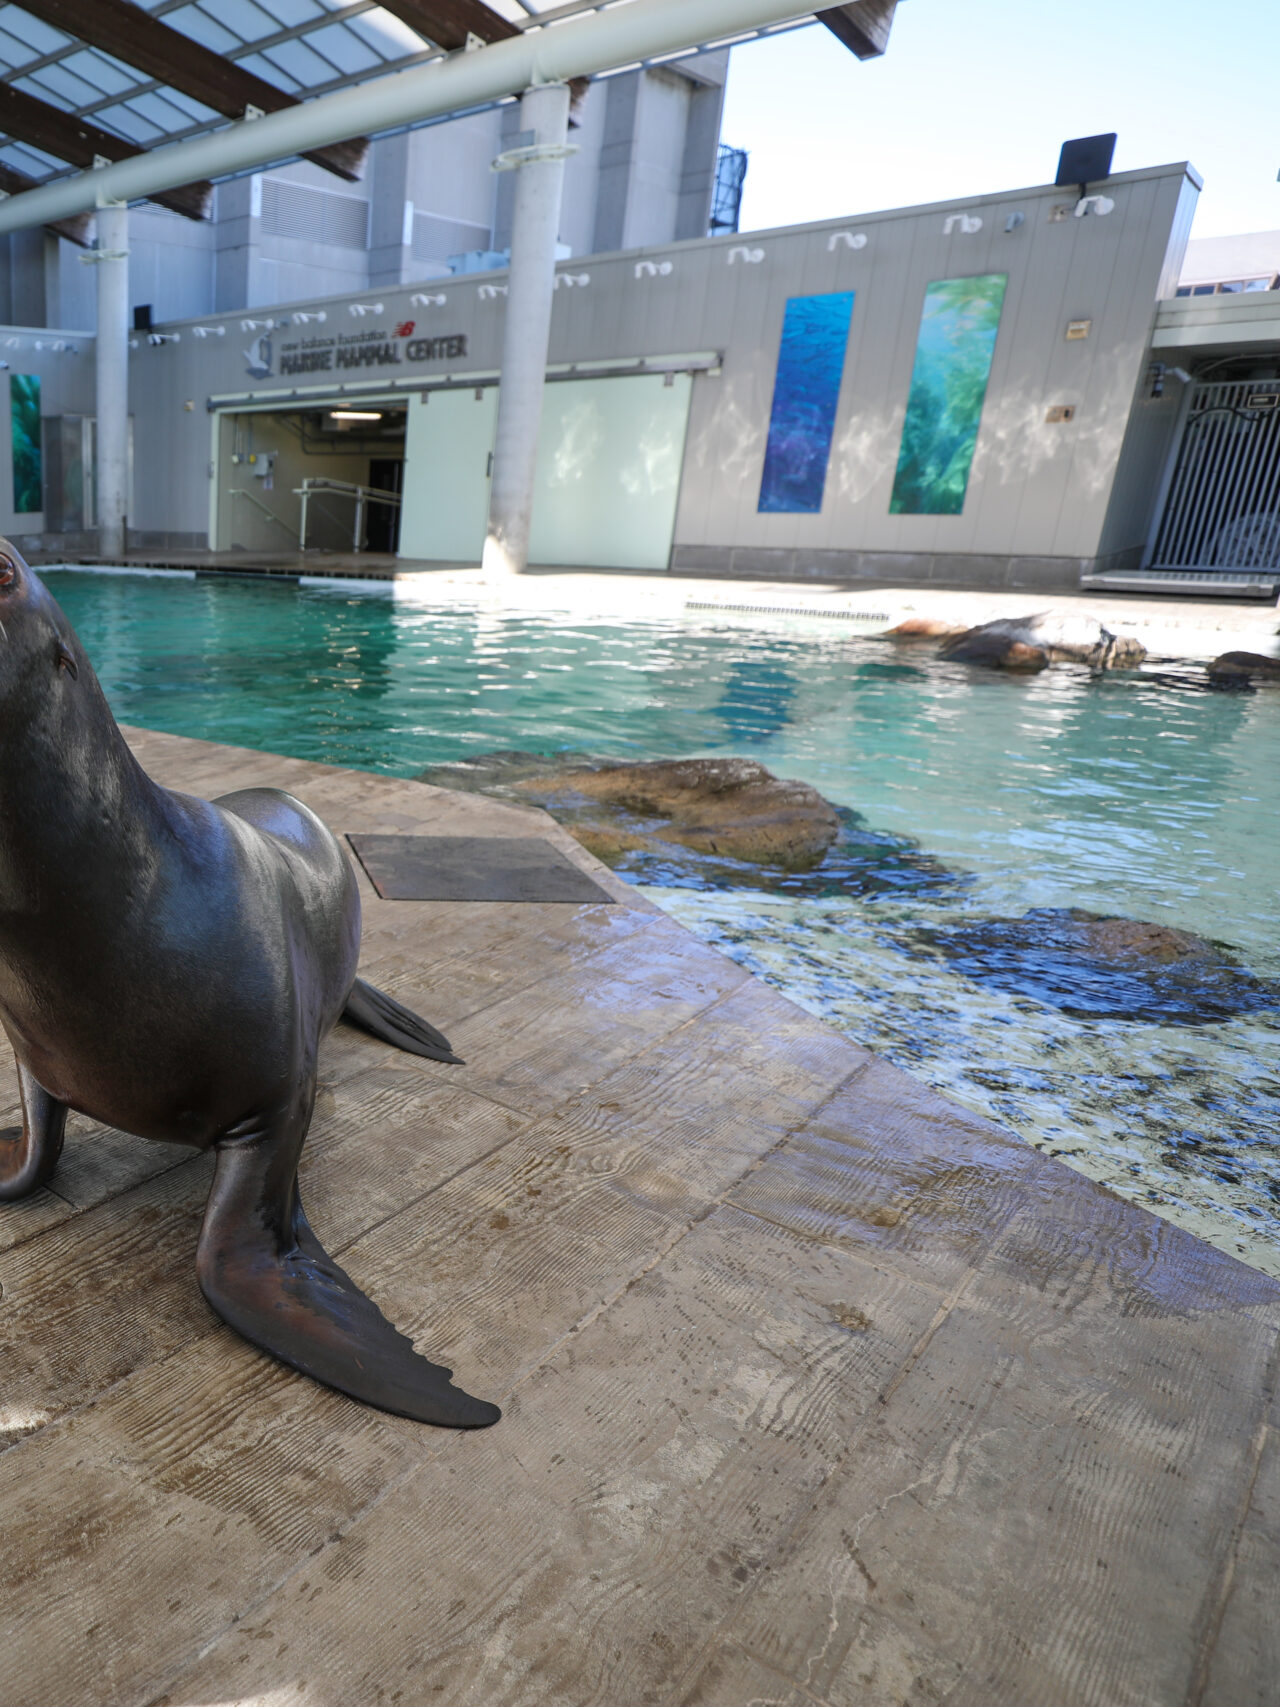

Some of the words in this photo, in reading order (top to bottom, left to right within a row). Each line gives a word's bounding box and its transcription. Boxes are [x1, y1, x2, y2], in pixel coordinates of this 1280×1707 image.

[280, 349, 332, 376] MARINE
[336, 342, 402, 369] MAMMAL
[406, 333, 467, 362] CENTER
[301, 336, 335, 350] balance
[338, 330, 387, 345] foundation
